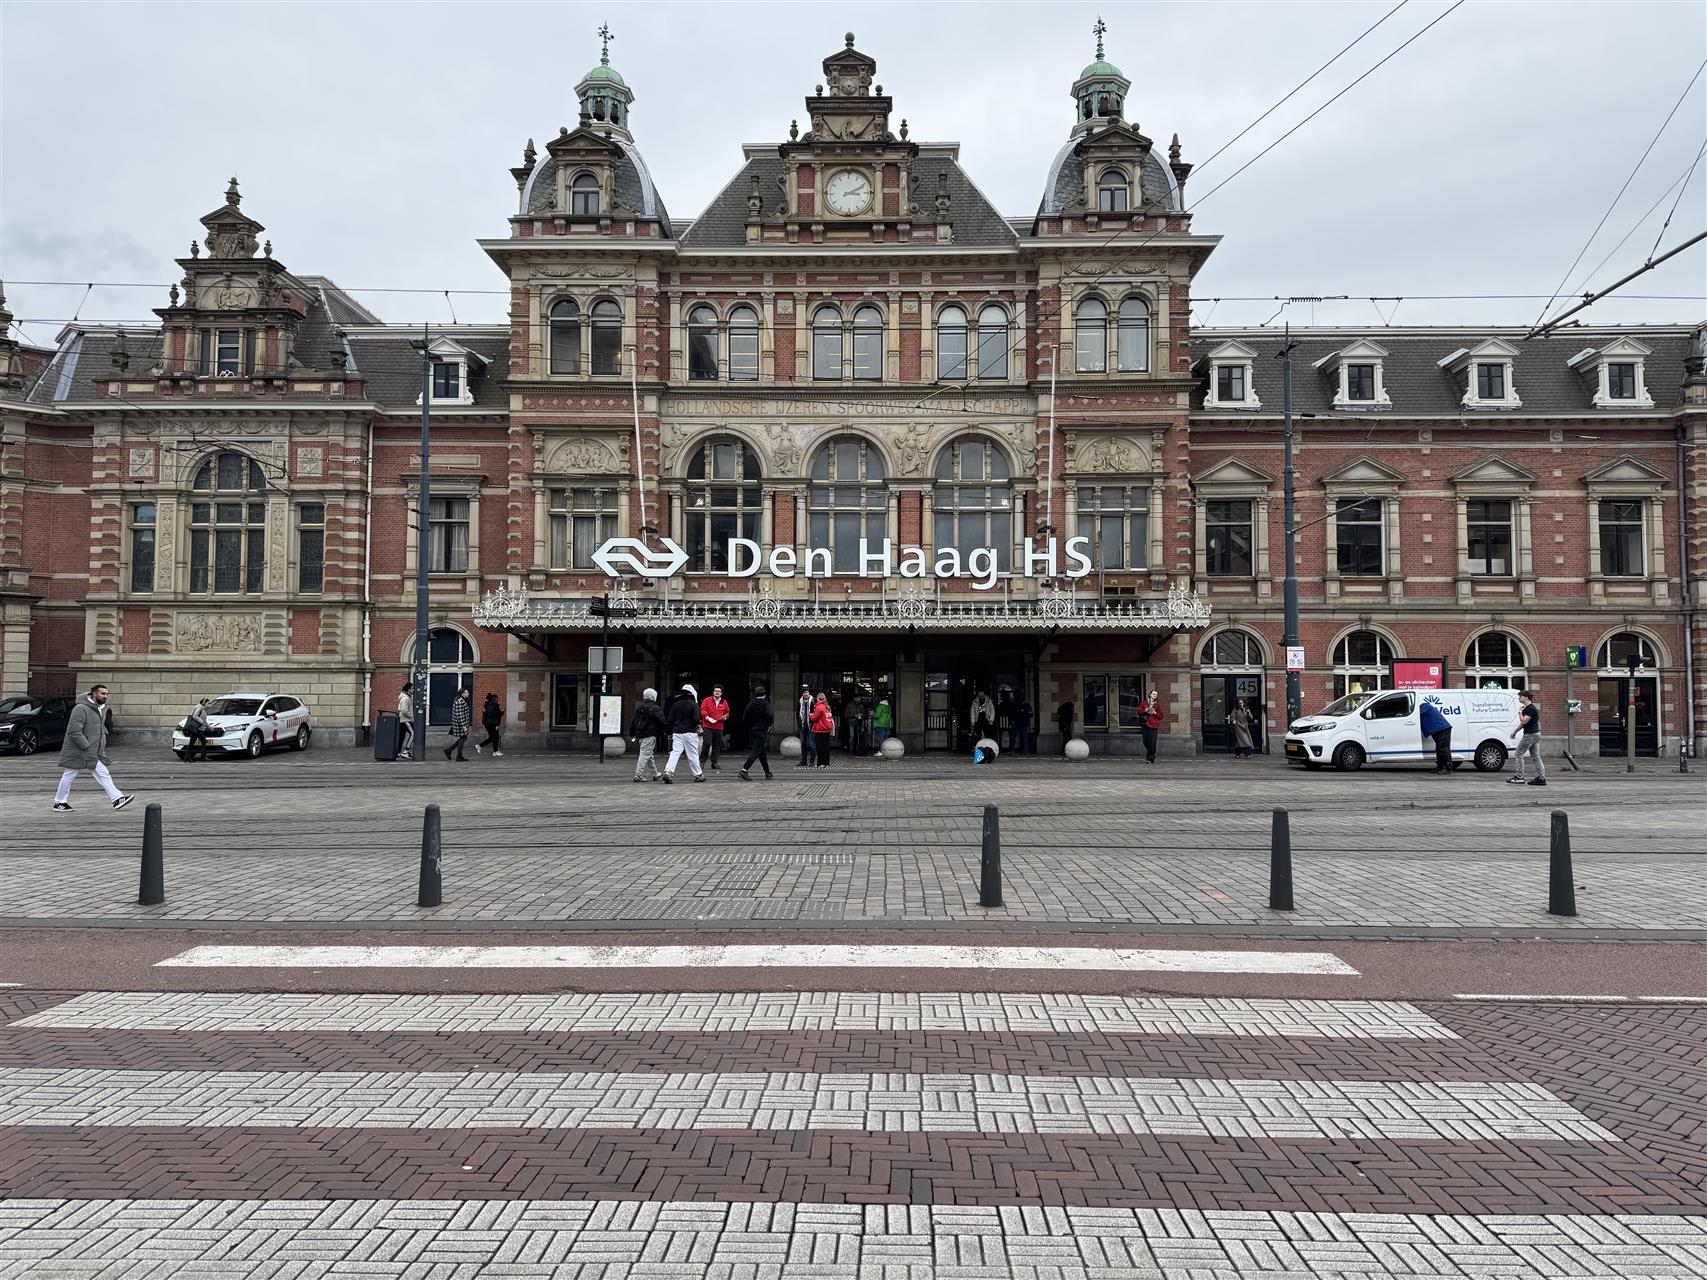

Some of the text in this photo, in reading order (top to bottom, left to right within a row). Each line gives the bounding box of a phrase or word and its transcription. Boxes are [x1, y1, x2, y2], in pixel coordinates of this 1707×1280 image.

[666, 400, 1030, 415] HOLLANDSCHE IJZEREN SPOORWEG MAATSCHAPPIJ
[728, 536, 1092, 590] Den Haag HS
[1238, 680, 1257, 693] 45
